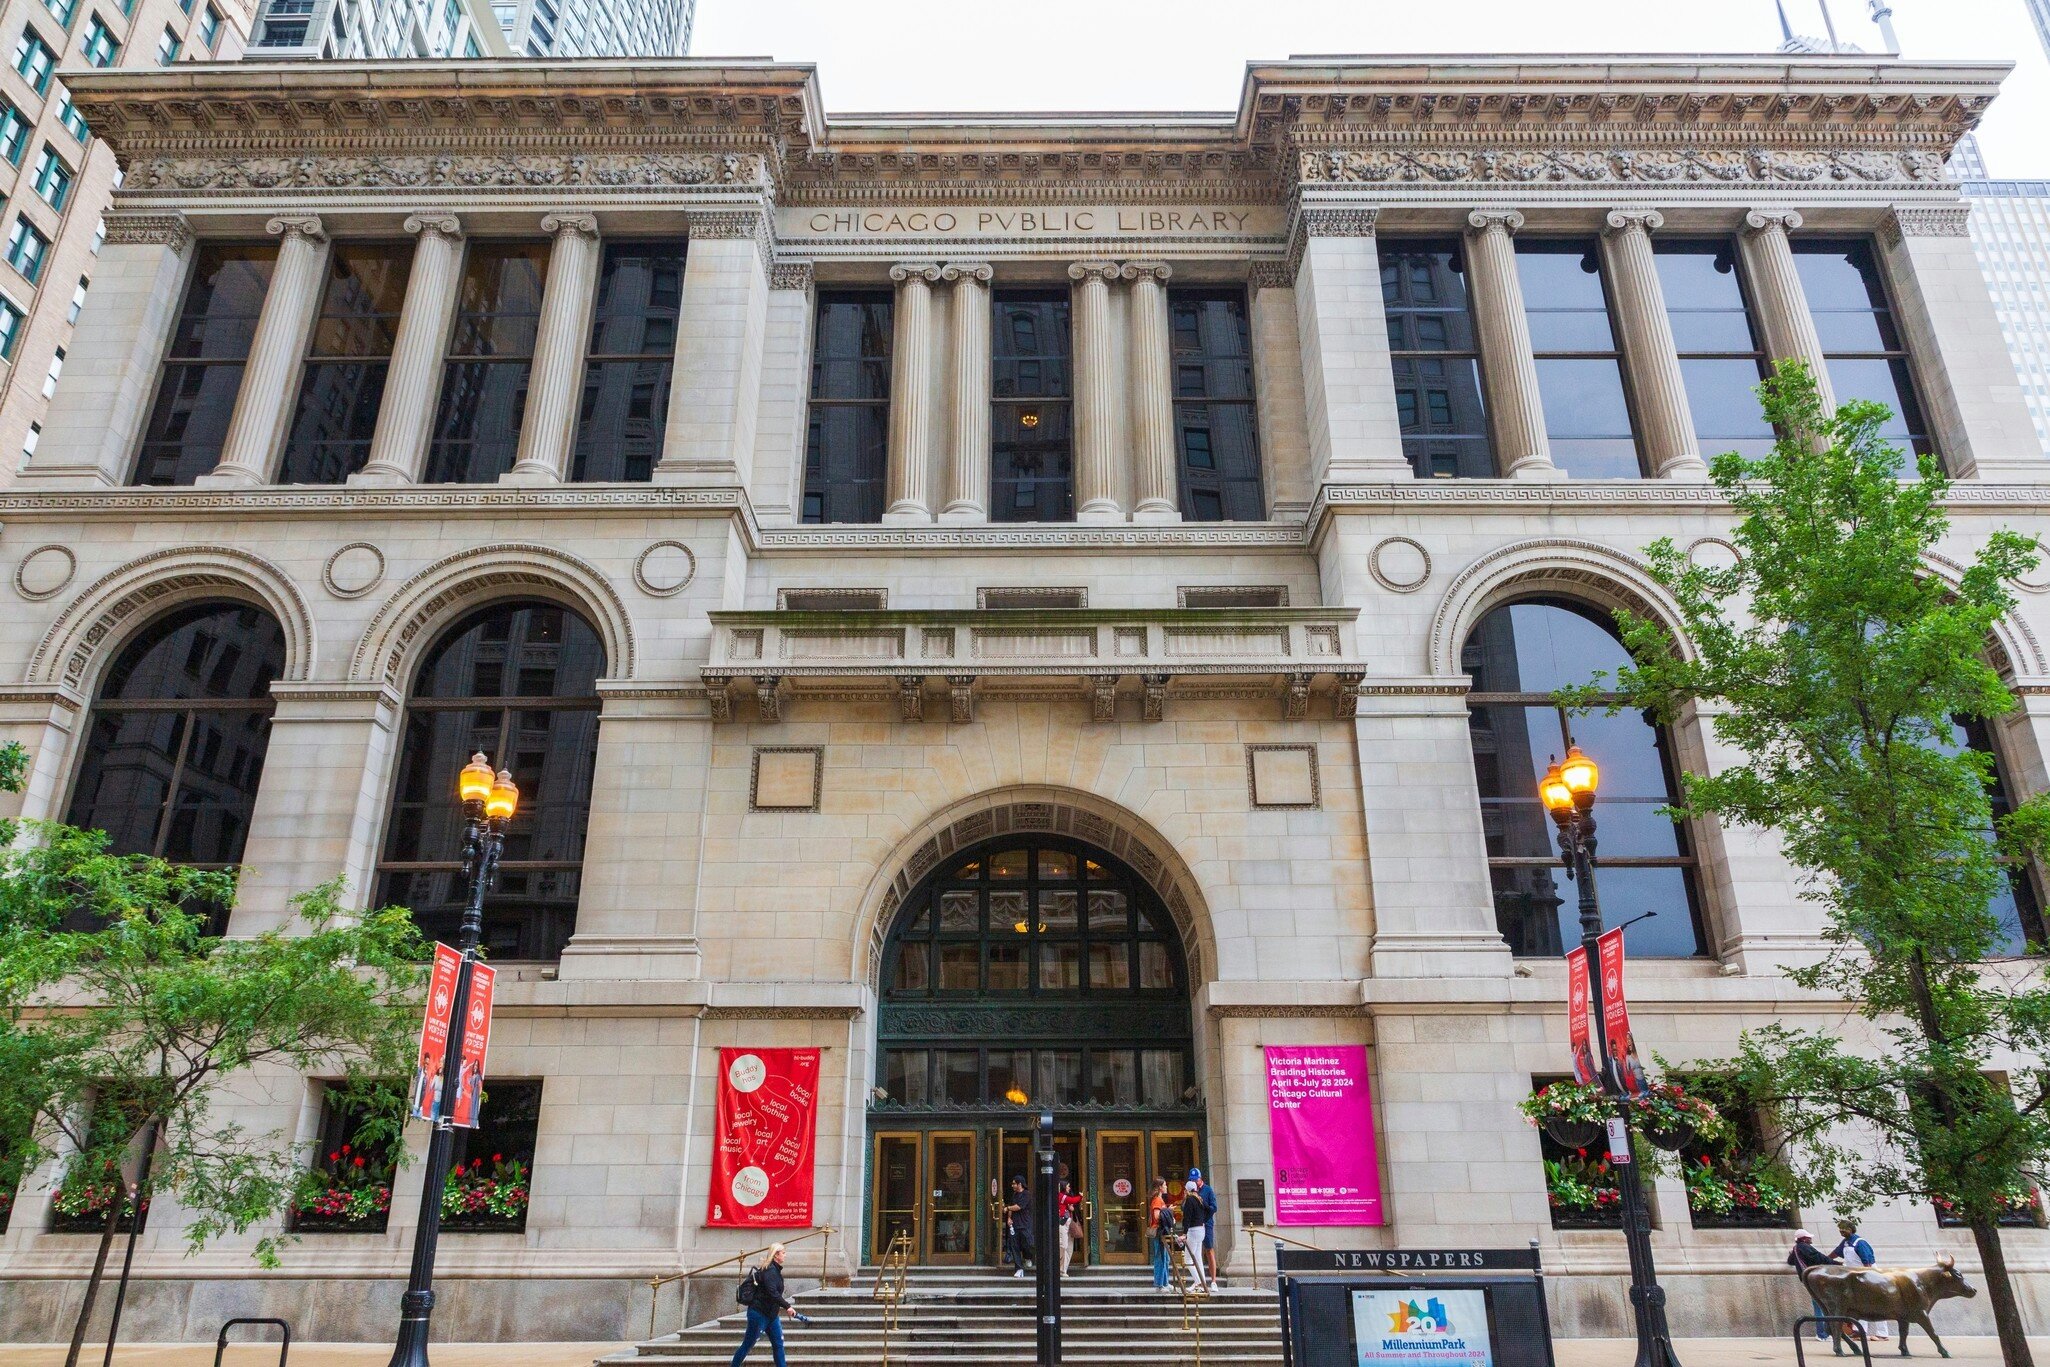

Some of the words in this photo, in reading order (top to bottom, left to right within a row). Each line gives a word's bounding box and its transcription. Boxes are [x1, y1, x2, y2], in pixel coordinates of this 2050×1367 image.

[809, 212, 957, 232] CHICAGO
[977, 211, 1095, 232] PVBLIC
[1117, 211, 1251, 231] LIBRARY
[1269, 1057, 1302, 1065] Victoria
[1303, 1057, 1340, 1065] Martinez
[735, 1065, 758, 1078] Buddy
[1270, 1068, 1307, 1077] Braiding
[1308, 1068, 1346, 1076] Histories
[742, 1075, 756, 1084] has
[1271, 1079, 1292, 1088] April
[1333, 1079, 1354, 1087] 2024
[795, 1084, 812, 1098] local
[1272, 1089, 1307, 1099] Chicago
[1308, 1089, 1343, 1098] Cultural
[789, 1090, 809, 1107] books
[1272, 1100, 1301, 1108] Center
[769, 1099, 788, 1112] local
[734, 1110, 753, 1119] local
[760, 1104, 790, 1123] clothing
[731, 1118, 758, 1130] jewelry
[755, 1129, 773, 1138] local
[723, 1136, 742, 1145] local
[783, 1137, 801, 1149] local
[720, 1145, 743, 1153] music
[779, 1143, 798, 1158] home
[773, 1152, 796, 1166] goods
[743, 1174, 761, 1186] from
[735, 1181, 765, 1197] Chicago
[1334, 1252, 1484, 1267] NEWSPAPERS
[1405, 1316, 1437, 1333] 20
[1423, 1351, 1467, 1359] Throughout
[1468, 1350, 1485, 1358] 2024
